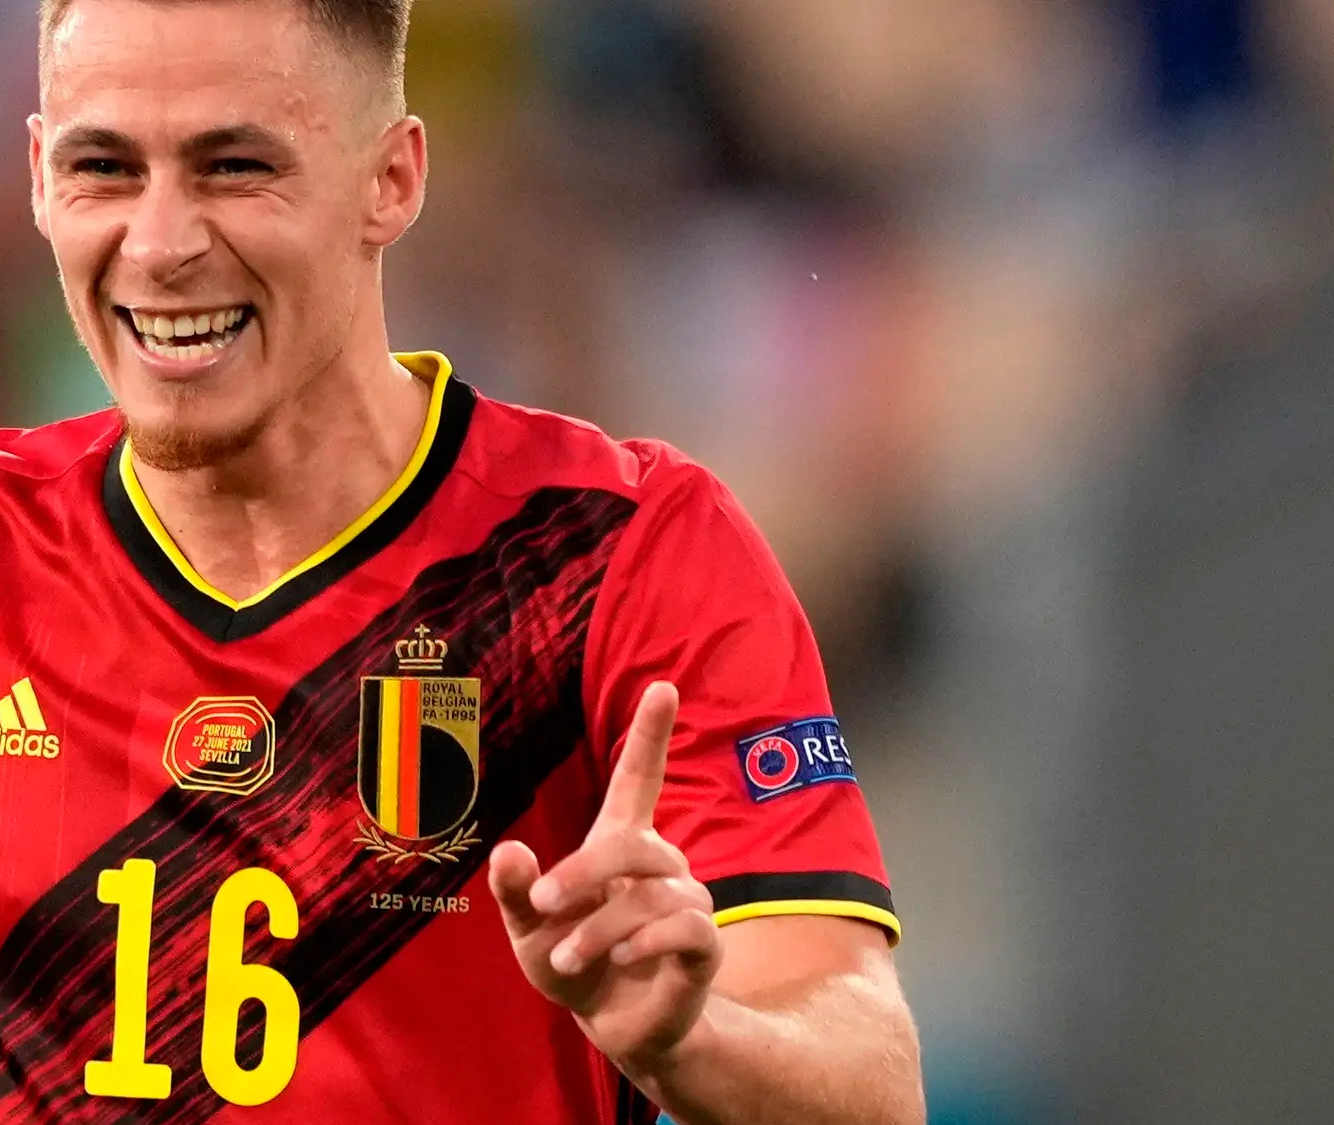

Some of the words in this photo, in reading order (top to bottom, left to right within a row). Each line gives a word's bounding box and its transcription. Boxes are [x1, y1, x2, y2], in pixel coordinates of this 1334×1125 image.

[422, 683, 464, 695] ROYAL
[422, 696, 477, 708] BELGIAN
[202, 724, 247, 738] PORTUGAL
[192, 735, 205, 748] 27
[205, 737, 229, 750] JUNE
[230, 739, 252, 753] 2021
[752, 740, 783, 757] UEFA
[199, 749, 240, 764] SEVILLA
[369, 892, 404, 910] 125
[409, 895, 470, 913] YEARS
[84, 857, 301, 1106] 16
